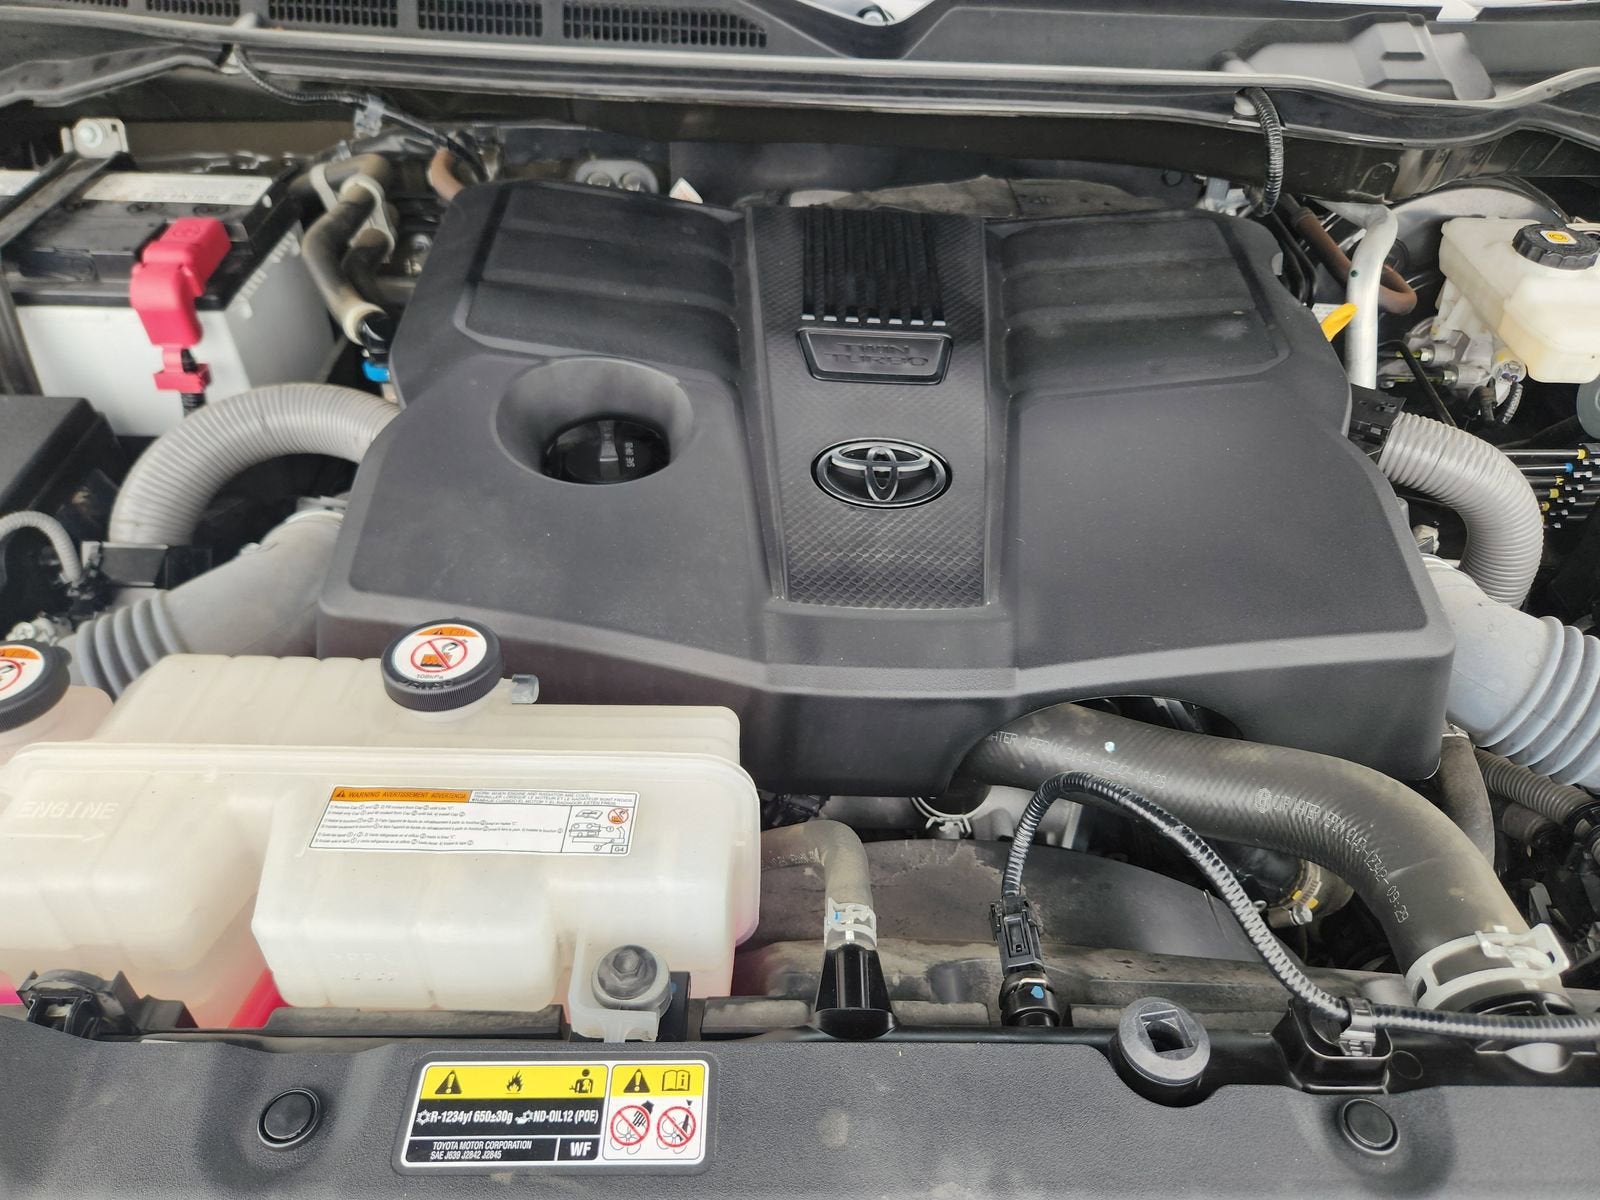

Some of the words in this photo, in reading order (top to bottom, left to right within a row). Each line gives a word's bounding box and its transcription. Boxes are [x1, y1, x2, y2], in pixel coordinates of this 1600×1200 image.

[837, 342, 910, 354] TWIN
[824, 353, 929, 366] TURBO
[15, 800, 119, 819] ENGINE
[430, 1110, 474, 1125] R-1234yf
[473, 1110, 514, 1125] 650±30g
[533, 1110, 572, 1123] ND-OIL12
[574, 1110, 598, 1125] (POE)
[432, 1142, 458, 1150] TOYOTA
[459, 1141, 484, 1150] MOTOR
[484, 1140, 532, 1150] CORPORATION
[570, 1142, 592, 1157] WF
[430, 1151, 444, 1160] SAE
